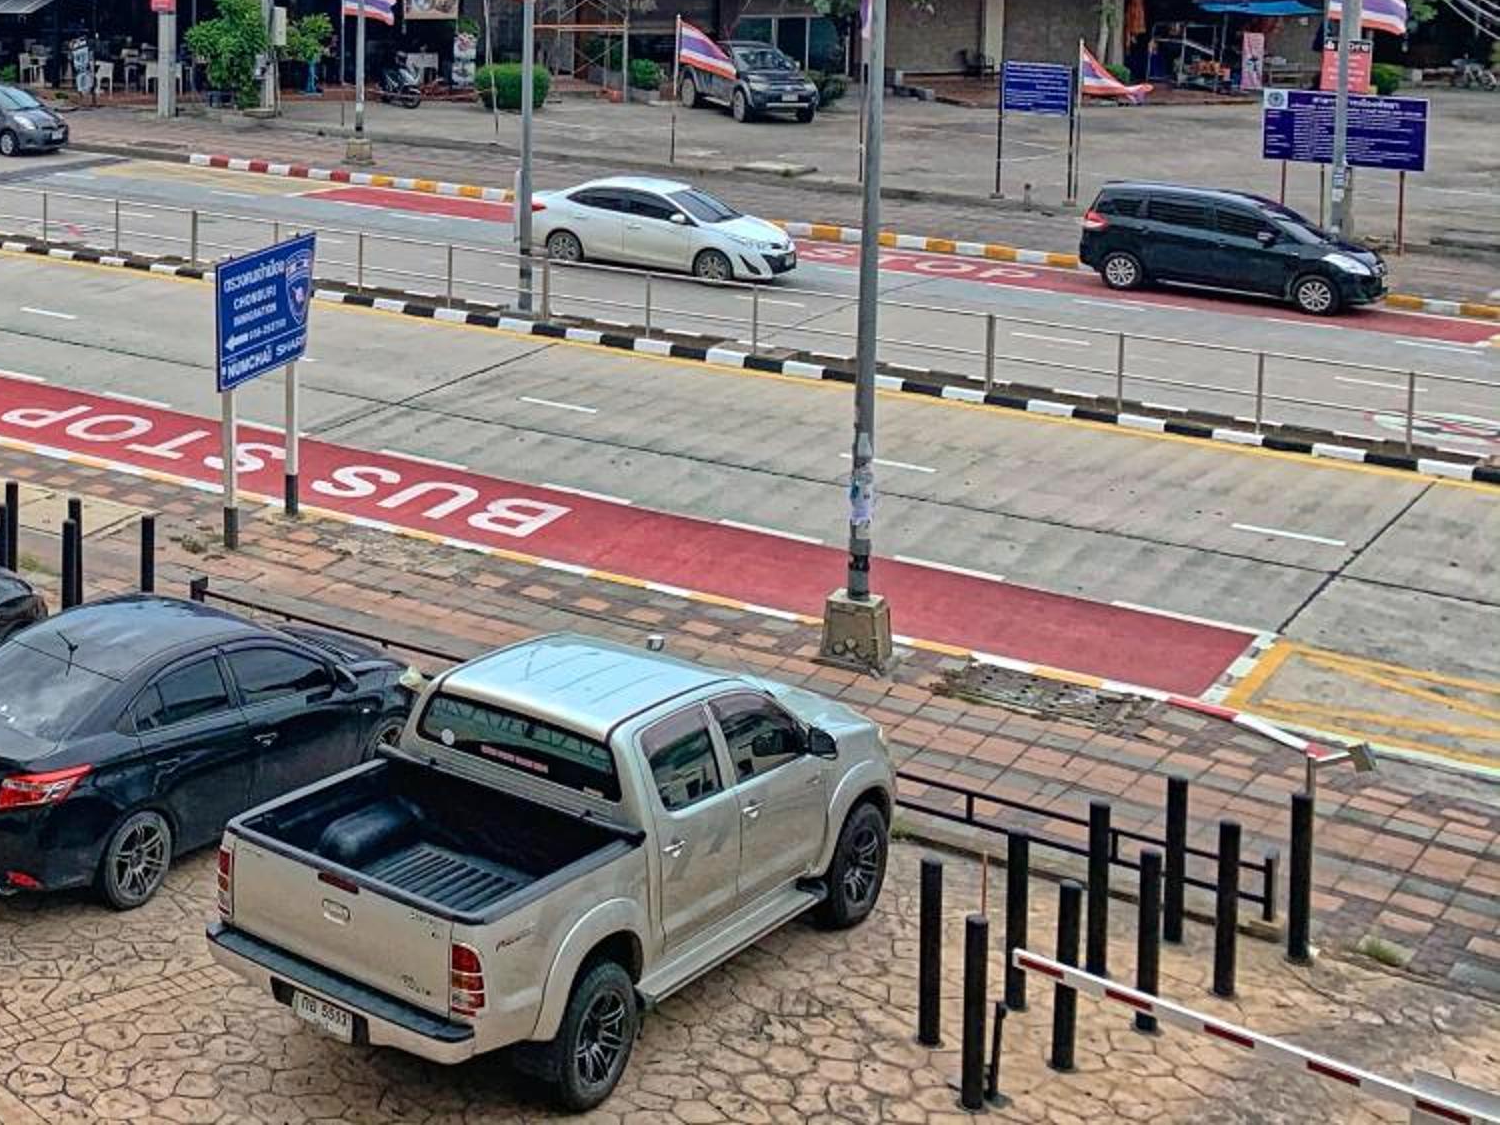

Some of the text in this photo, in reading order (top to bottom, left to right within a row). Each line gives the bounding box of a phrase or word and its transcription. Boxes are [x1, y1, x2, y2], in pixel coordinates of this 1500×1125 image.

[233, 285, 277, 311] CHONBURI
[0, 405, 573, 538] BUS STOP
